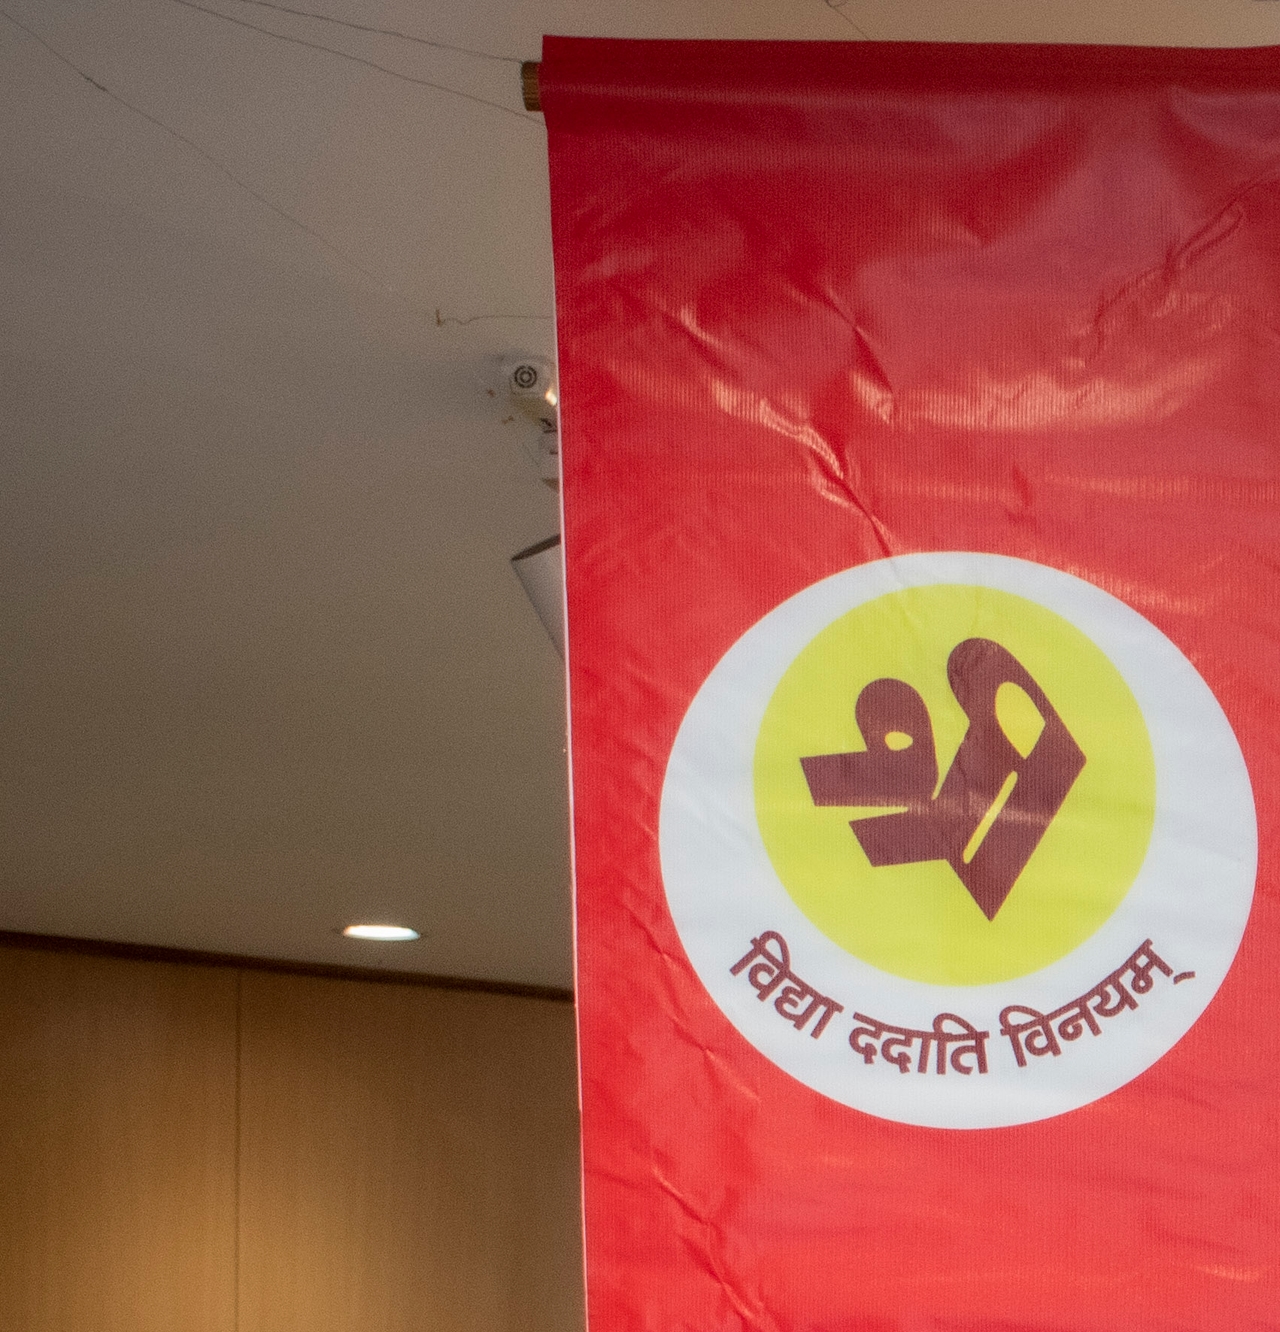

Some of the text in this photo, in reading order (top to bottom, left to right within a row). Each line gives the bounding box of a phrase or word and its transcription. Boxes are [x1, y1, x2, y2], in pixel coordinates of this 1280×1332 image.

[730, 931, 1195, 1075] विद्या ददाति विनयम्
